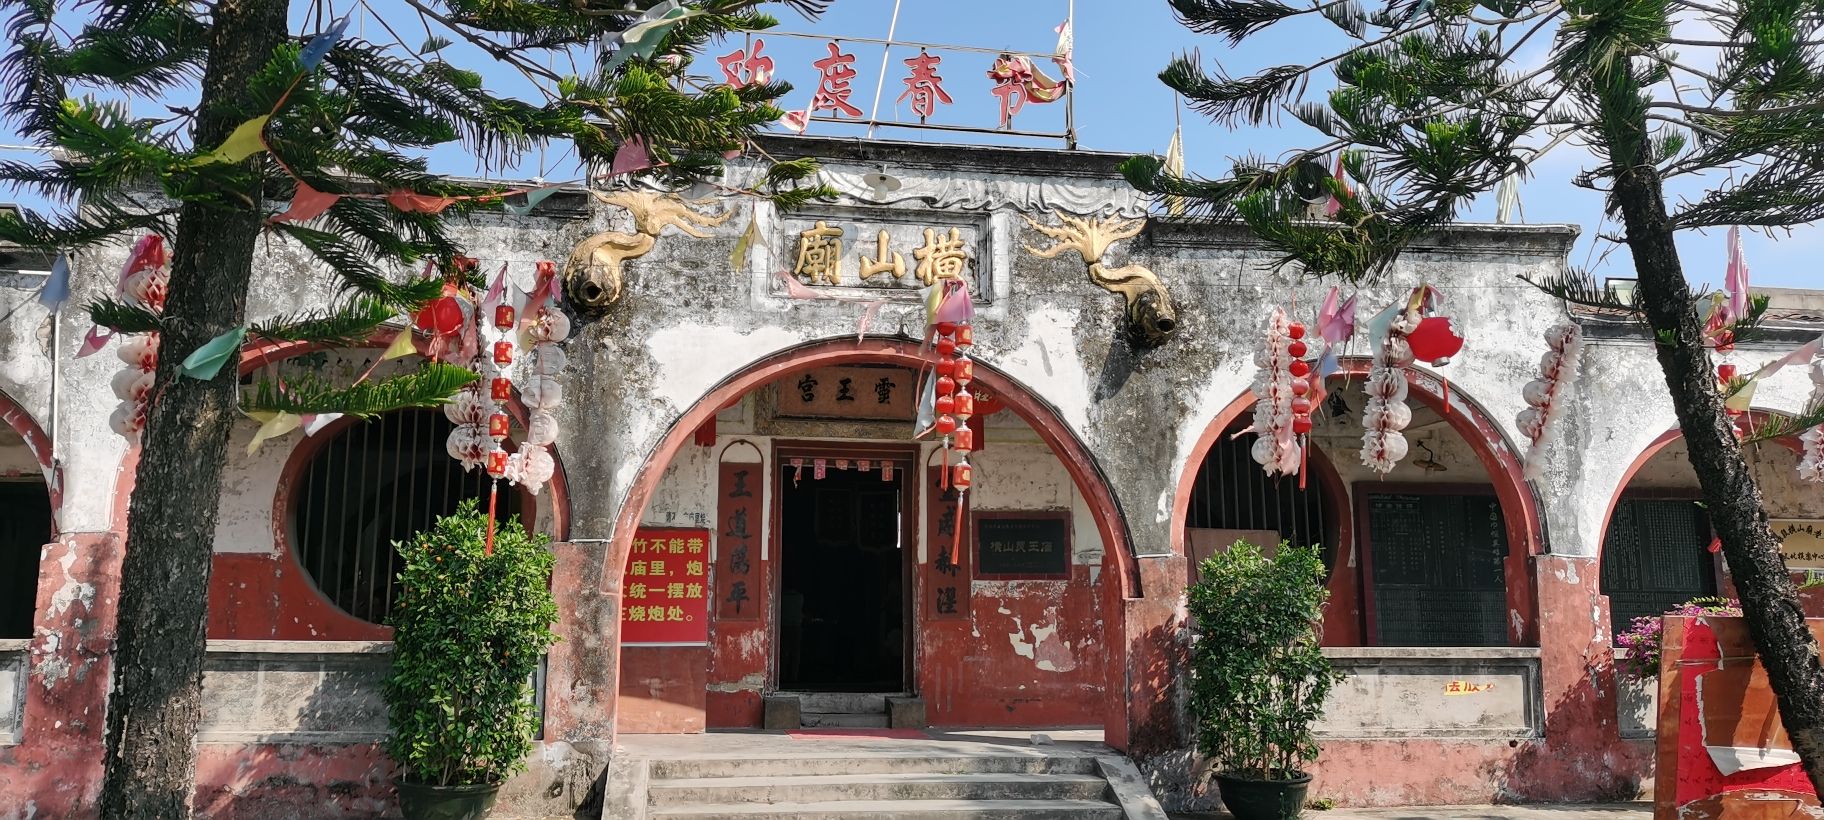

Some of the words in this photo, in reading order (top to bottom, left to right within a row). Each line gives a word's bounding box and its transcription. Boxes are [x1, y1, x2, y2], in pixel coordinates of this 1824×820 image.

[623, 559, 704, 576] 庙里，炮
[622, 582, 703, 599] 统一摆放
